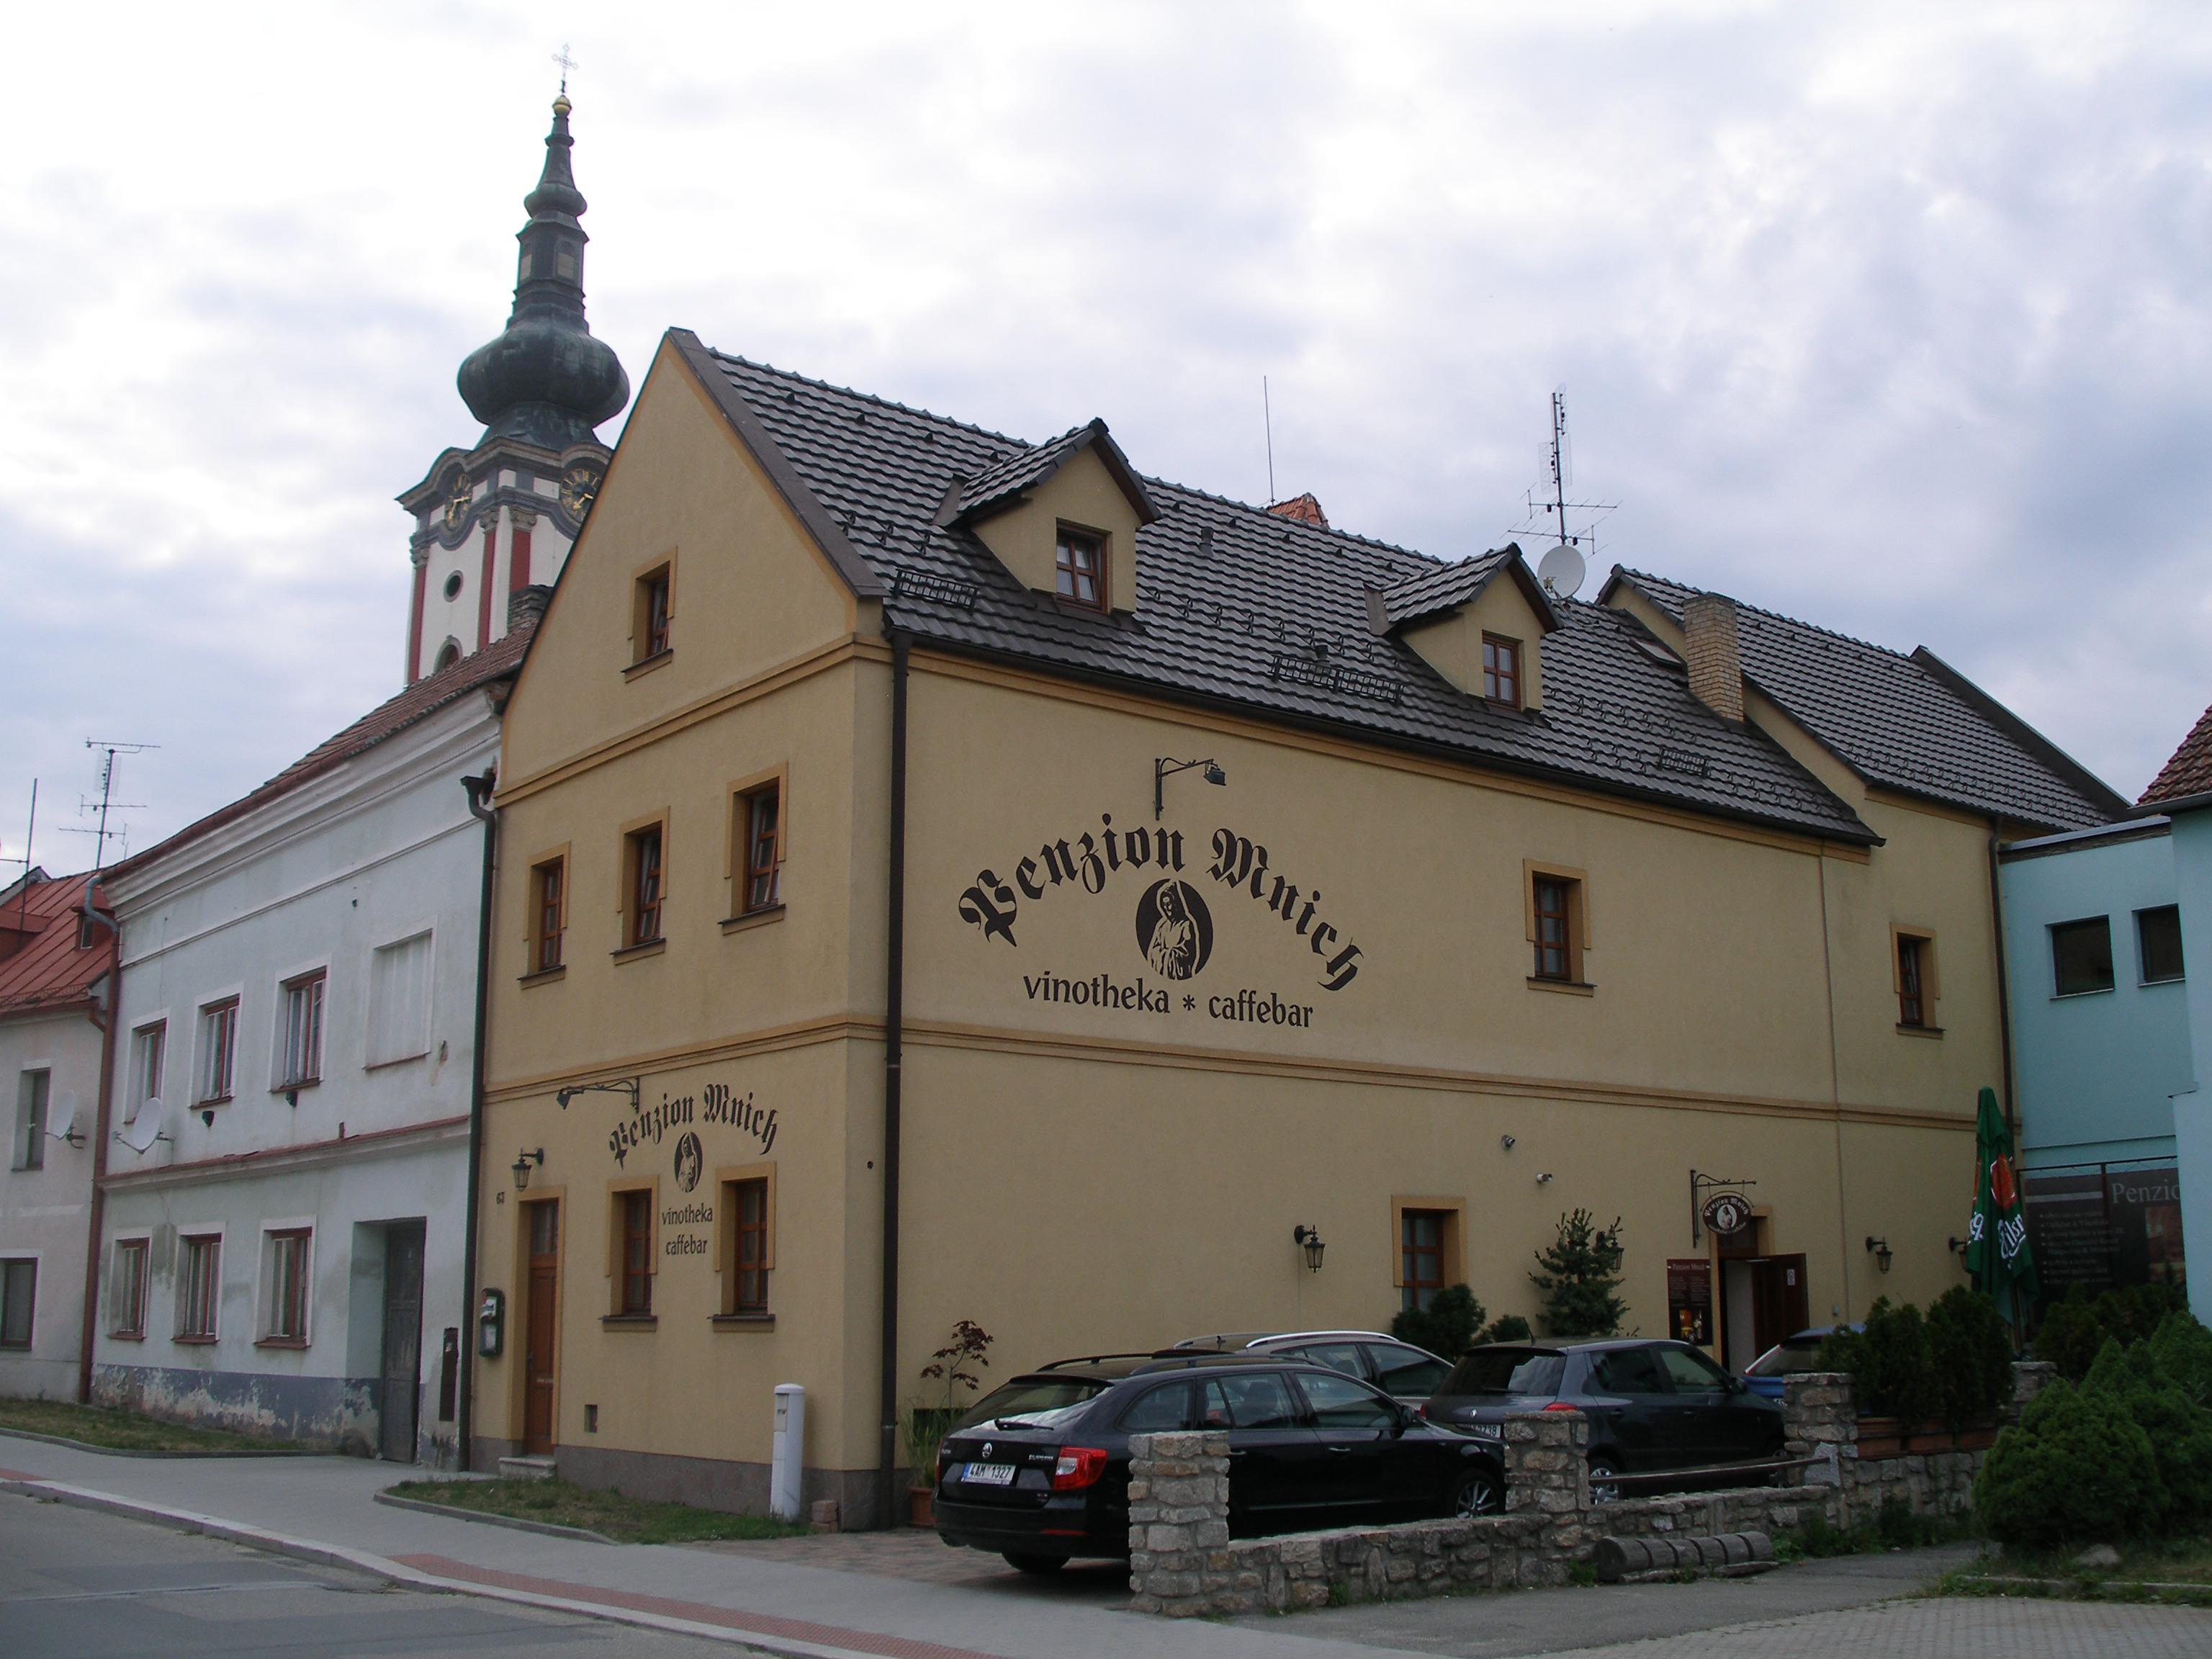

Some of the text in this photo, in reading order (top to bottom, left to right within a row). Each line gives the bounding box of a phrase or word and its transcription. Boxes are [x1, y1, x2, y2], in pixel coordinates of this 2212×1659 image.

[958, 813, 1364, 992] Penzion Mnich
[1023, 971, 1170, 1013] vinotheka
[1208, 989, 1313, 1028] caffebar
[609, 1083, 778, 1170] Penzion Mnich
[662, 1202, 713, 1226] vinotheka
[665, 1234, 709, 1256] caffebar
